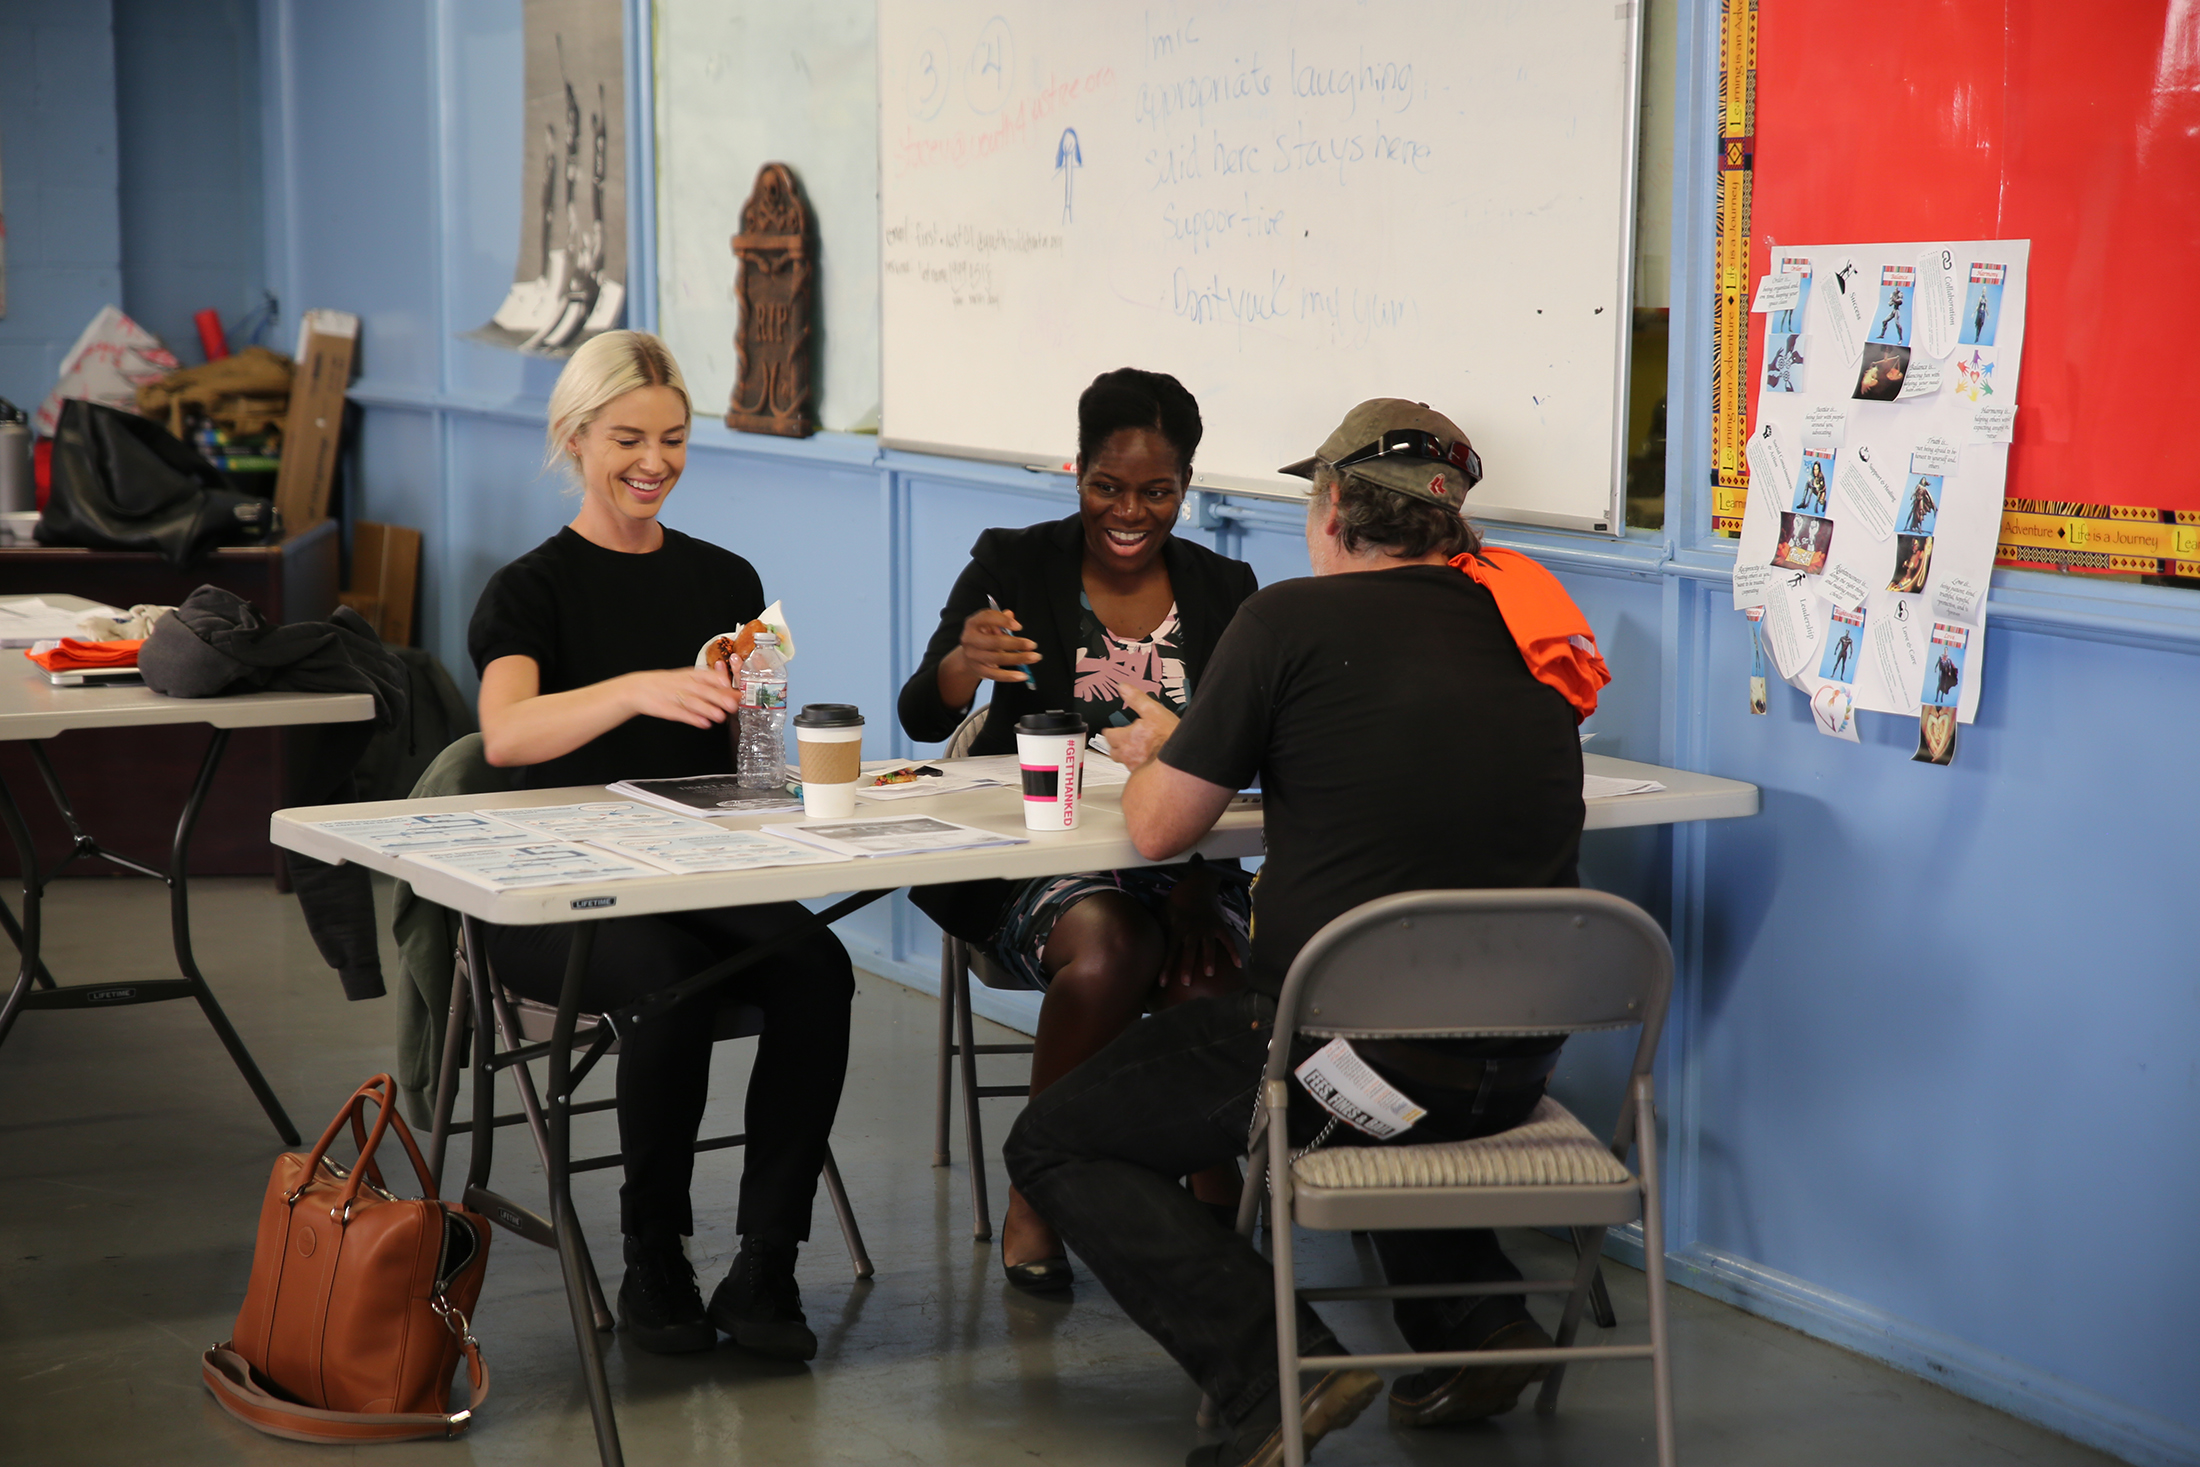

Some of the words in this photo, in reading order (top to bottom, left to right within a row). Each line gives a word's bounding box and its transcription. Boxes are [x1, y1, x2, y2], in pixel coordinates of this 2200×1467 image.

[1733, 34, 1743, 52] an
[1732, 54, 1742, 65] is
[1730, 64, 1745, 126] Learning
[1729, 181, 1742, 232] Journey
[1728, 248, 1738, 261] is
[1725, 263, 1738, 289] Life
[1976, 270, 1999, 278] Harmony
[1849, 291, 1861, 321] Success
[1944, 275, 1955, 326] Collaboration
[755, 303, 789, 343] RIP
[1724, 311, 1735, 381] Adventure
[1726, 382, 1734, 396] an
[1725, 402, 1734, 412] is
[1722, 412, 1736, 471] Learning
[1868, 463, 1882, 482] Support
[1883, 483, 1897, 503] Healing
[2004, 517, 2054, 539] Adventure
[2069, 523, 2091, 545] Life
[2092, 530, 2102, 542] is
[2103, 532, 2111, 543] a
[2113, 530, 2159, 554] Journey
[1799, 598, 1814, 640] Leadership
[1901, 625, 1910, 642] Love
[1908, 648, 1918, 666] Care
[1943, 631, 1955, 640] Love
[1063, 739, 1076, 827] #GETTHANKED
[577, 898, 611, 908] LIFETIME
[93, 989, 131, 999] LIFETIME
[1327, 1094, 1362, 1122] FINES
[1355, 1113, 1369, 1127] &
[499, 1210, 521, 1226] LIFETIME
